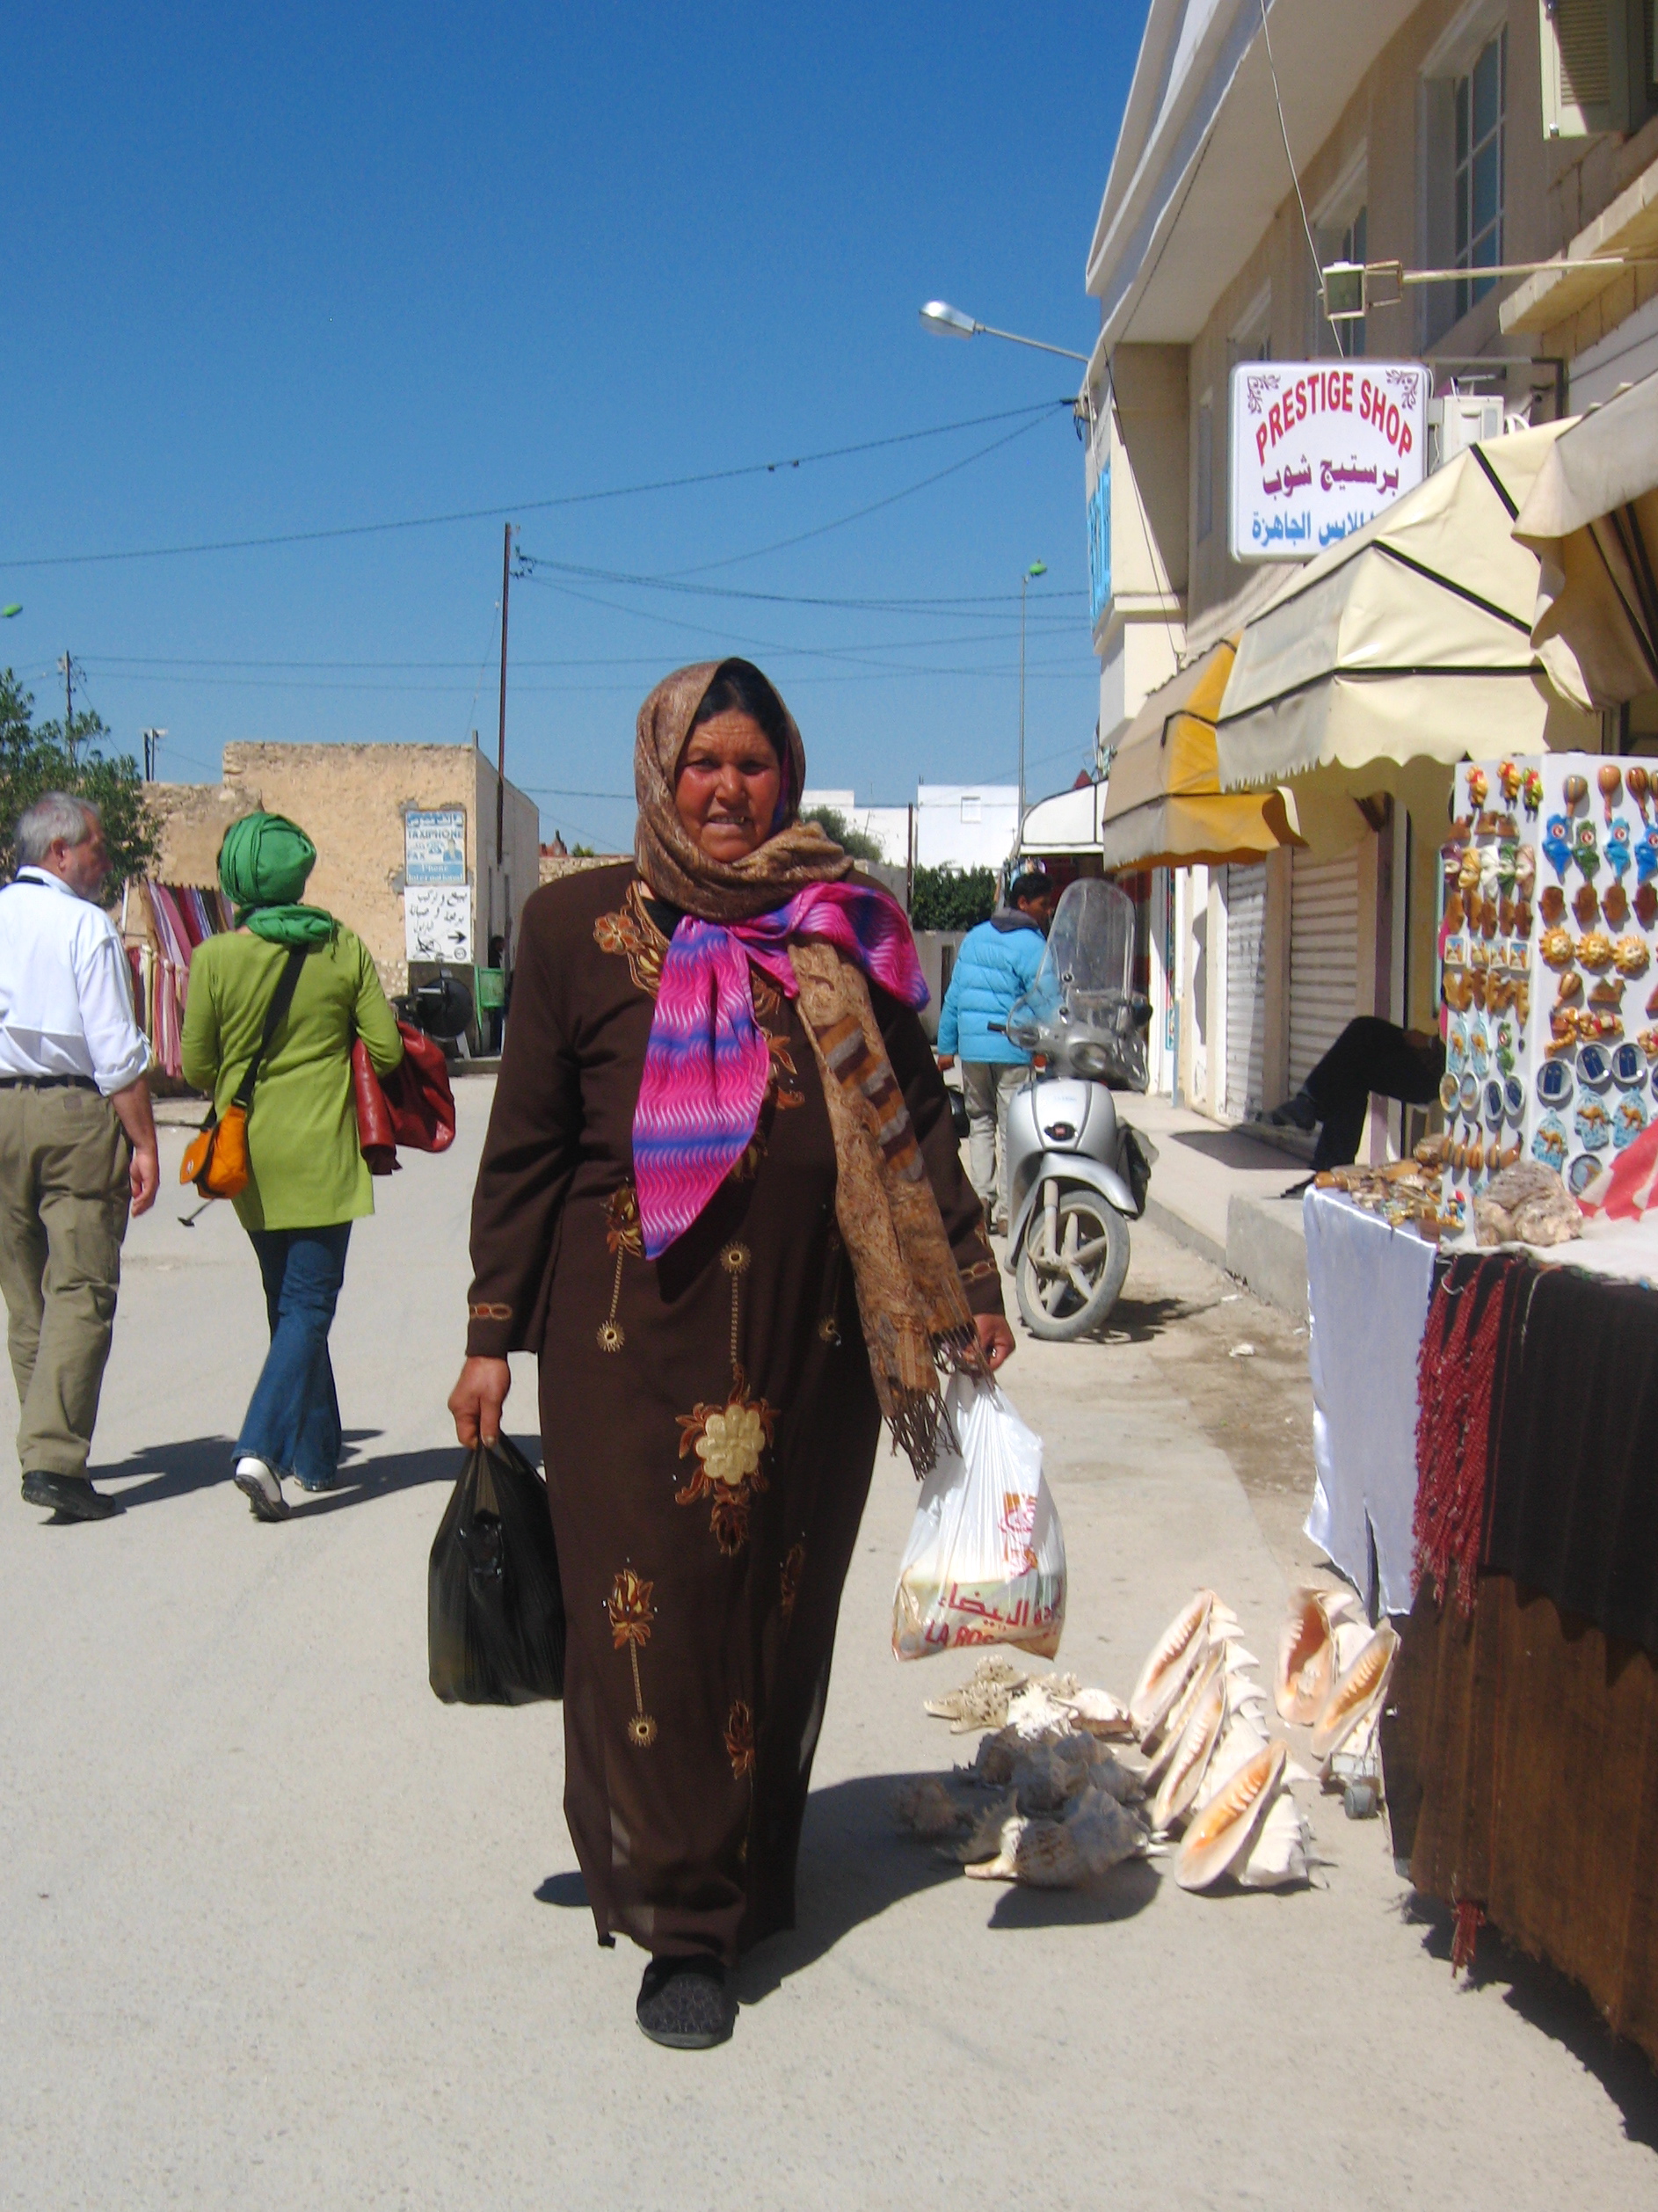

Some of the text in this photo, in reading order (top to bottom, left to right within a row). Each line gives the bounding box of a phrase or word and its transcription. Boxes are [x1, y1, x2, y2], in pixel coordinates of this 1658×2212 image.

[1255, 370, 1413, 467] PRESTIGE SHOP
[1262, 455, 1399, 500] برستيج شوب
[1252, 510, 1312, 546] الجاهزة
[408, 829, 462, 840] TAXIPHONE
